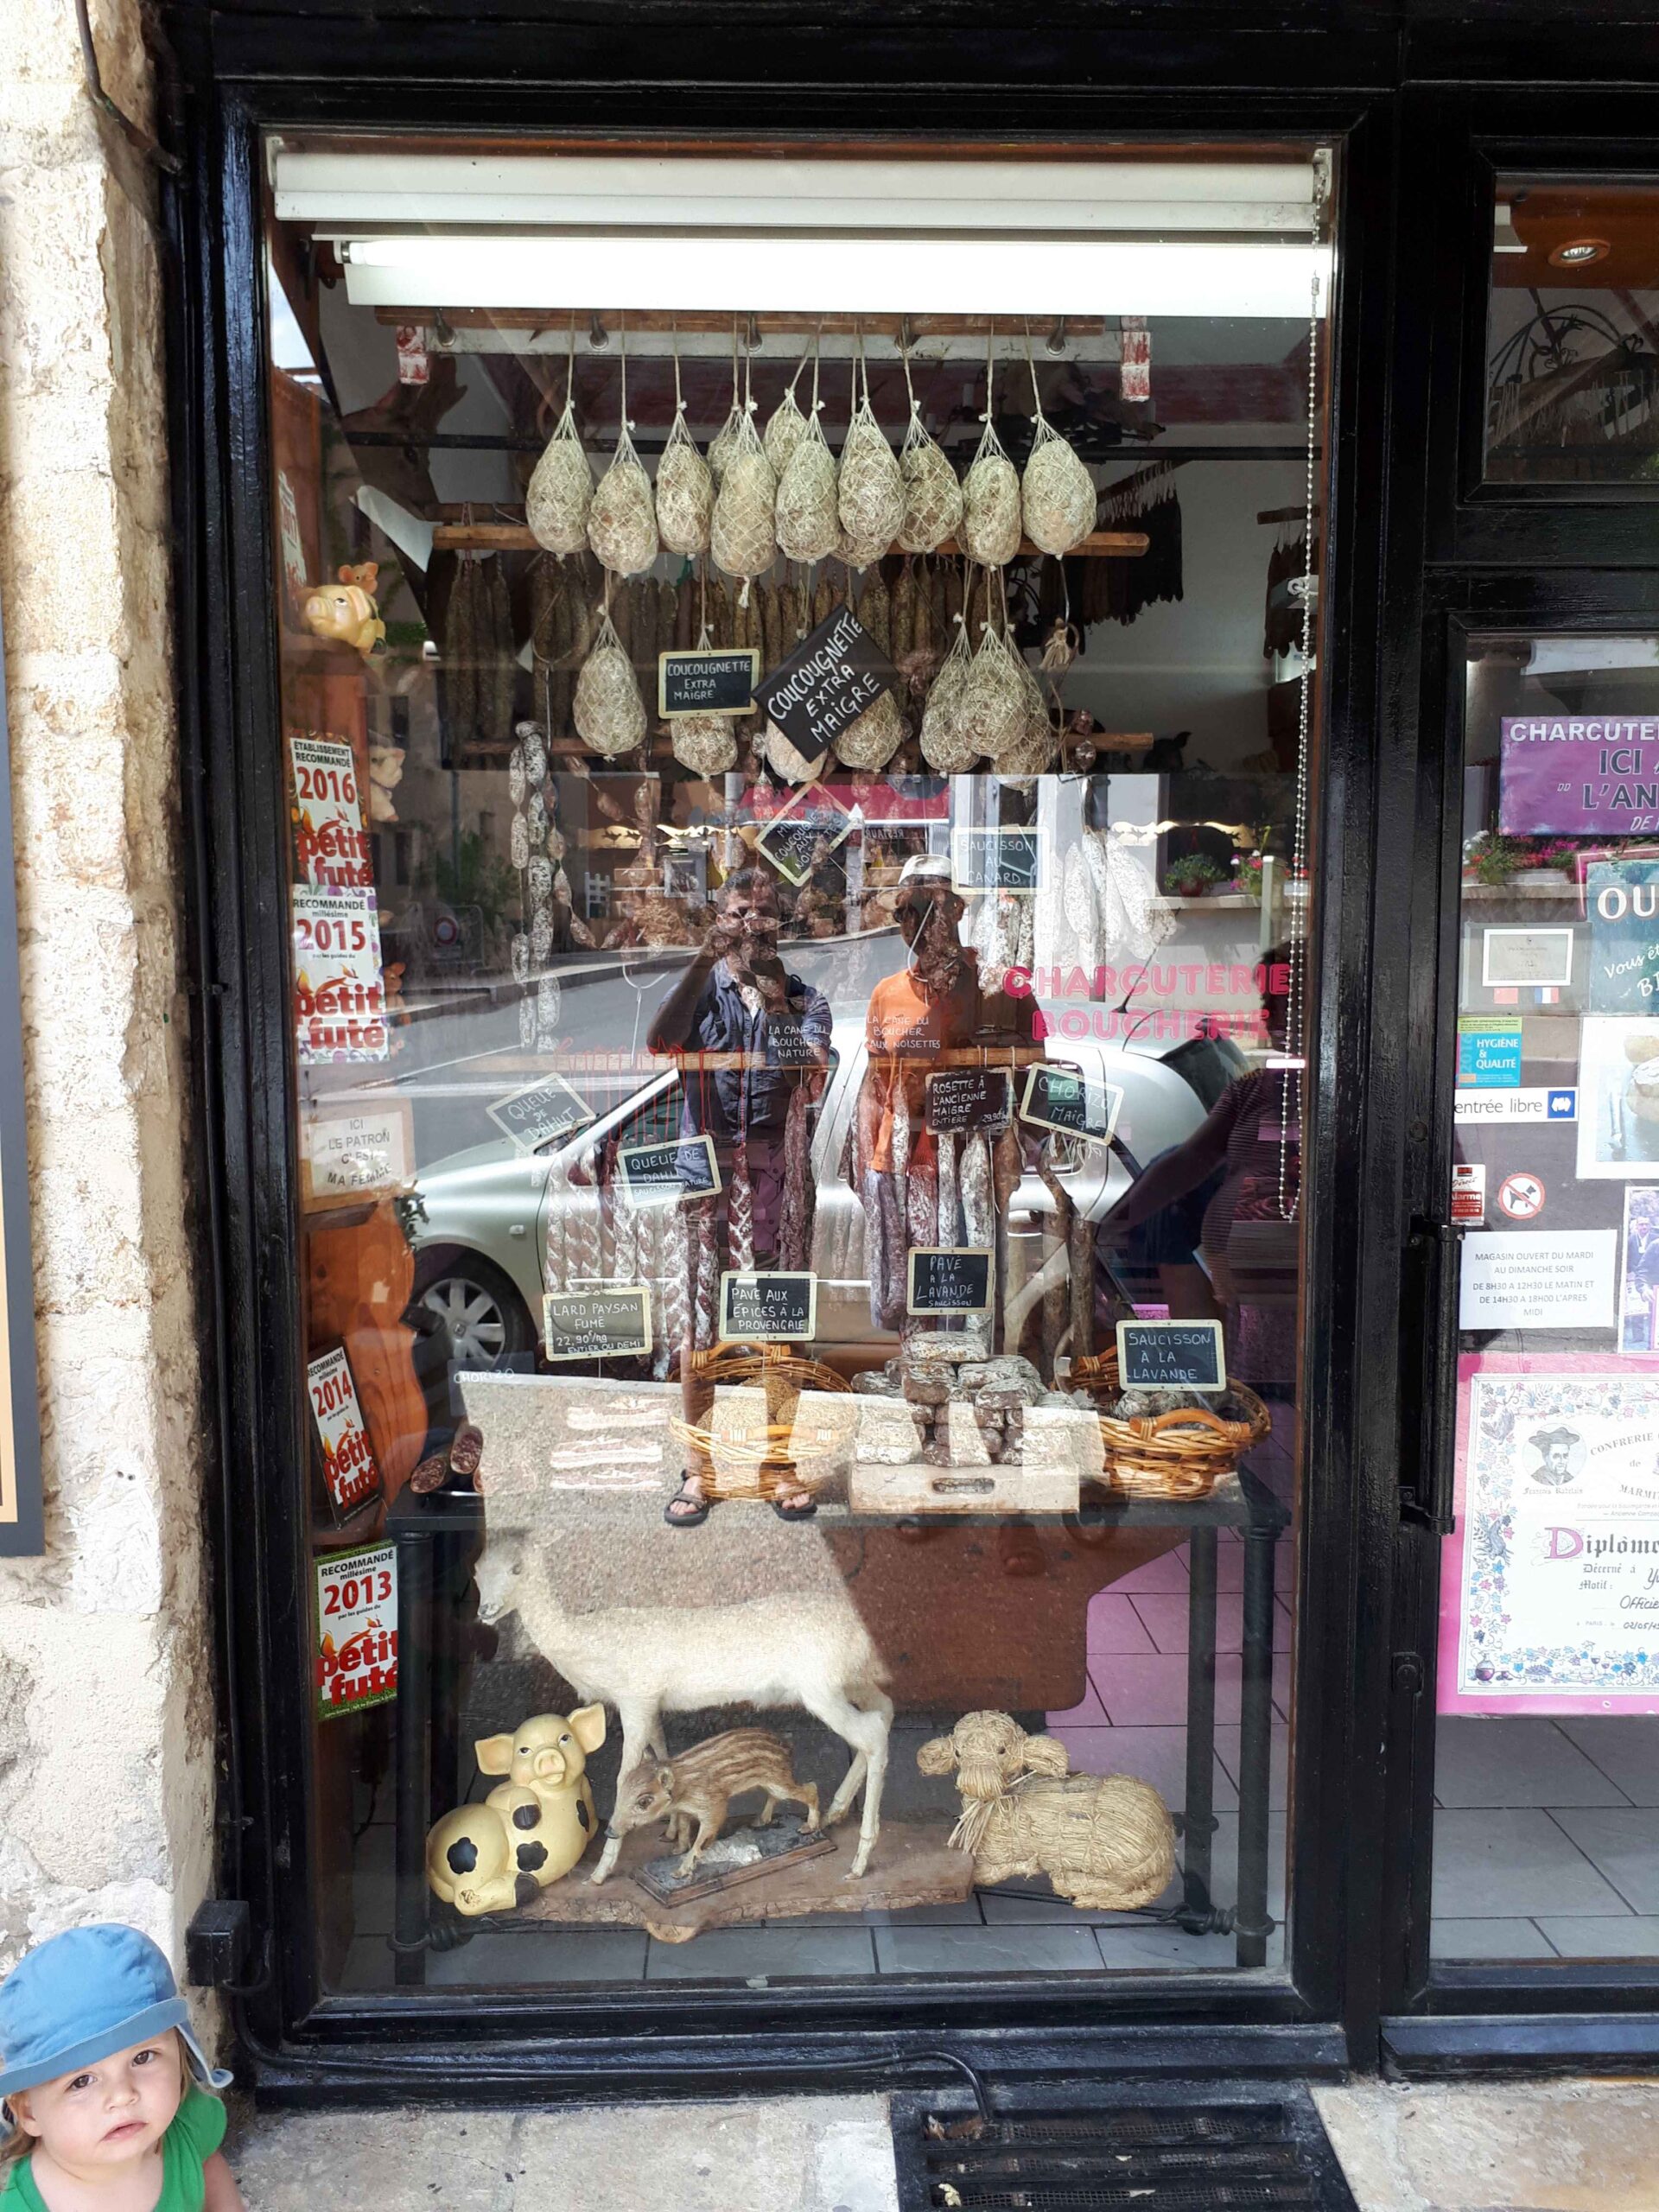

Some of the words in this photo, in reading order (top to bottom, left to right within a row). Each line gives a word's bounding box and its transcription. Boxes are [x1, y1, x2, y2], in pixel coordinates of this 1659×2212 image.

[667, 659, 751, 677] COUCOUGNETTE
[768, 611, 863, 721] COUCOUGNETTE
[805, 664, 855, 718] EXTRA
[1510, 722, 1659, 742] CHARCUTE
[1599, 748, 1643, 776] ICI
[296, 766, 356, 805] 2016
[1630, 815, 1654, 831] DE
[296, 826, 372, 862] petit
[959, 838, 1035, 853] SAUCISSON
[985, 855, 1001, 868] AU
[314, 855, 374, 887] futé
[967, 869, 1021, 885] CANARD
[296, 918, 366, 951] 2015
[1604, 954, 1645, 979] Vous
[1001, 963, 1291, 999] CHARCUTERIE
[294, 983, 383, 1026] petit
[768, 1025, 780, 1036] LA
[874, 1026, 925, 1037] BOUCHER
[1030, 1008, 1272, 1042] BOUCHERIE
[308, 1017, 385, 1050] futé
[772, 1037, 821, 1047] BOUCHER
[869, 1039, 888, 1049] AUX
[893, 1039, 941, 1049] NOISETTES
[1476, 1036, 1519, 1048] HYGIÈNE
[778, 1047, 821, 1058] NATURE
[1476, 1056, 1516, 1071] QUALITÉ
[932, 1078, 975, 1094] ROSETTE
[507, 1087, 557, 1121] QUEUE
[1455, 1099, 1503, 1114] entrée
[1510, 1097, 1542, 1113] libre
[532, 1108, 549, 1122] DE
[350, 1119, 364, 1130] ICI
[328, 1138, 342, 1150] LE
[346, 1131, 390, 1148] PATRON
[631, 1151, 678, 1171] QUEUE
[683, 1147, 700, 1161] DE
[327, 1172, 346, 1186] MA
[1516, 1252, 1549, 1261] OUVERT
[1554, 1265, 1574, 1274] SOIR
[941, 1273, 955, 1283] LA
[1485, 1282, 1507, 1291] 8H30
[1517, 1281, 1542, 1290] 12H30
[1555, 1281, 1583, 1289] MATIN
[766, 1289, 788, 1302] AUX
[916, 1283, 974, 1300] LAVANDE
[553, 1304, 586, 1317] LARD
[592, 1302, 639, 1315] PAYSAN
[791, 1306, 804, 1317] LA
[1523, 1308, 1543, 1317] MIDI
[601, 1342, 614, 1351] OU
[1159, 1351, 1176, 1363] LA
[1133, 1368, 1198, 1380] LAVANDE
[312, 1370, 353, 1418] 2014
[1590, 1433, 1654, 1456] CONFRERIE
[323, 1430, 372, 1491] petit
[1629, 1459, 1641, 1468] de
[339, 1459, 380, 1509] futé
[321, 1549, 394, 1578] RECOMMANDÉ
[340, 1566, 377, 1581] millésime
[323, 1570, 392, 1617] 2013
[356, 1606, 373, 1616] guides
[316, 1630, 397, 1688] petit
[329, 1660, 397, 1707] futé
